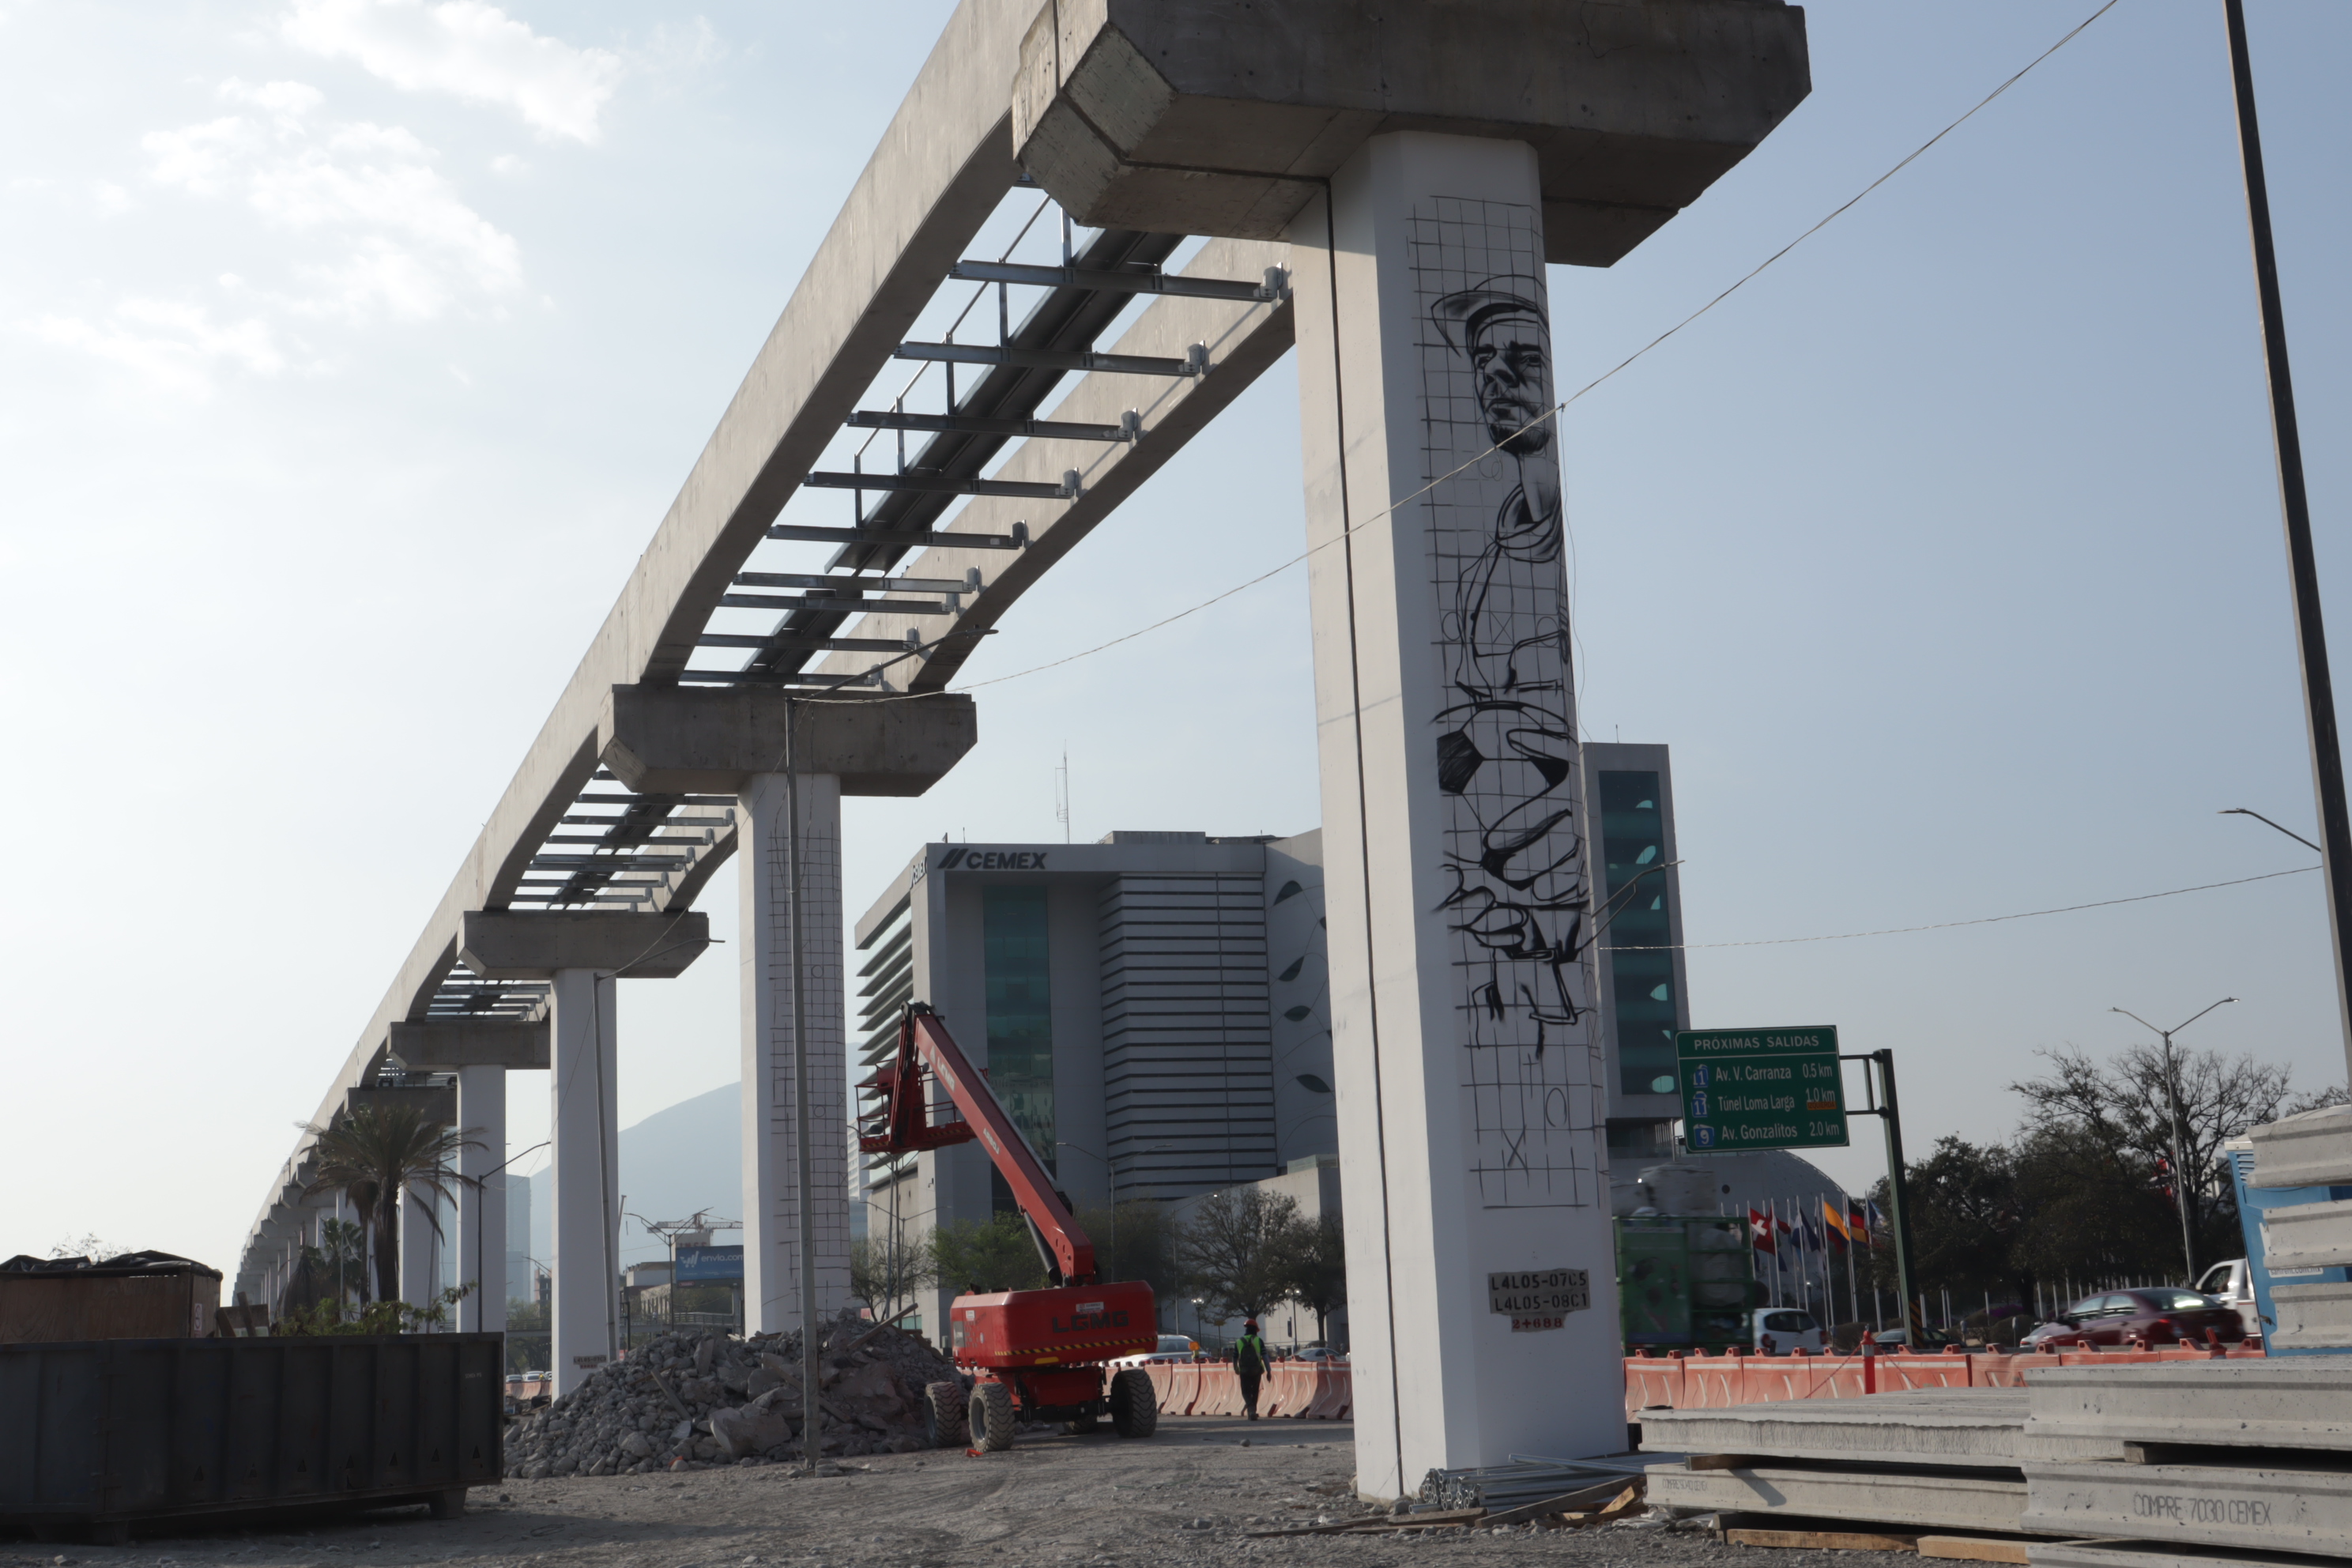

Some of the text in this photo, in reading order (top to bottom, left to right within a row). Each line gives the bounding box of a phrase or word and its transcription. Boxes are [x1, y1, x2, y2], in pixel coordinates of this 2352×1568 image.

[967, 852, 1048, 870] CEMEX
[1694, 1035, 1819, 1050] PRÓXIMAS SALIDAS
[1716, 1064, 1833, 1082] Av. V. Carranza 0.5 km
[1717, 1087, 1835, 1112] Túnel Loma Larga 1.0 km
[1699, 1129, 1709, 1144] 9
[1722, 1121, 1840, 1140] Av. Gonzalitos 2.0 km
[1491, 1272, 1587, 1291] L4L05-07C5
[1494, 1293, 1588, 1312] L4L05-08C1
[1052, 1310, 1129, 1333] LGMG
[1512, 1317, 1563, 1329] 2+688
[2134, 1492, 2272, 1526] COMPRE 7030 CEMEX
